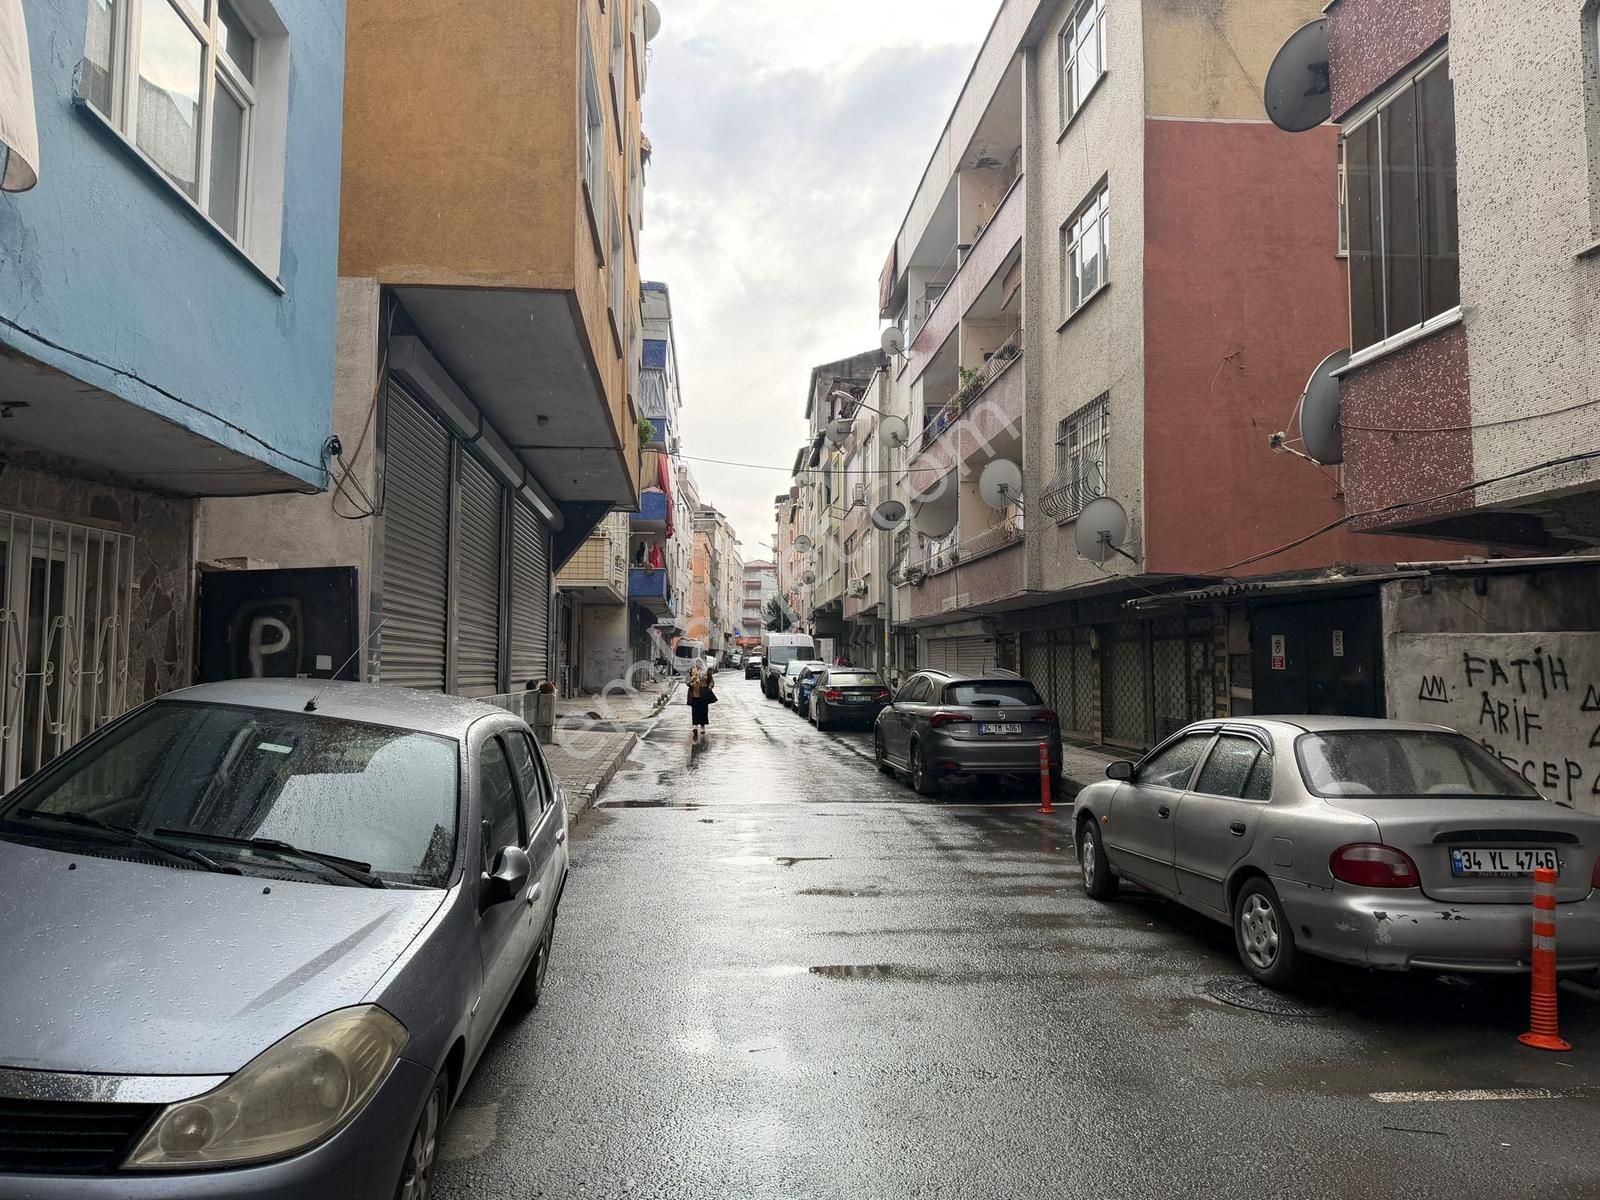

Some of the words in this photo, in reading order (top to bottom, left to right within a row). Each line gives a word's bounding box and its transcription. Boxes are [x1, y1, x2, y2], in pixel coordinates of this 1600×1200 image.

[250, 617, 290, 678] P
[1462, 851, 1482, 870] 34
[1489, 851, 1508, 870] YL
[1516, 851, 1554, 870] 4746
